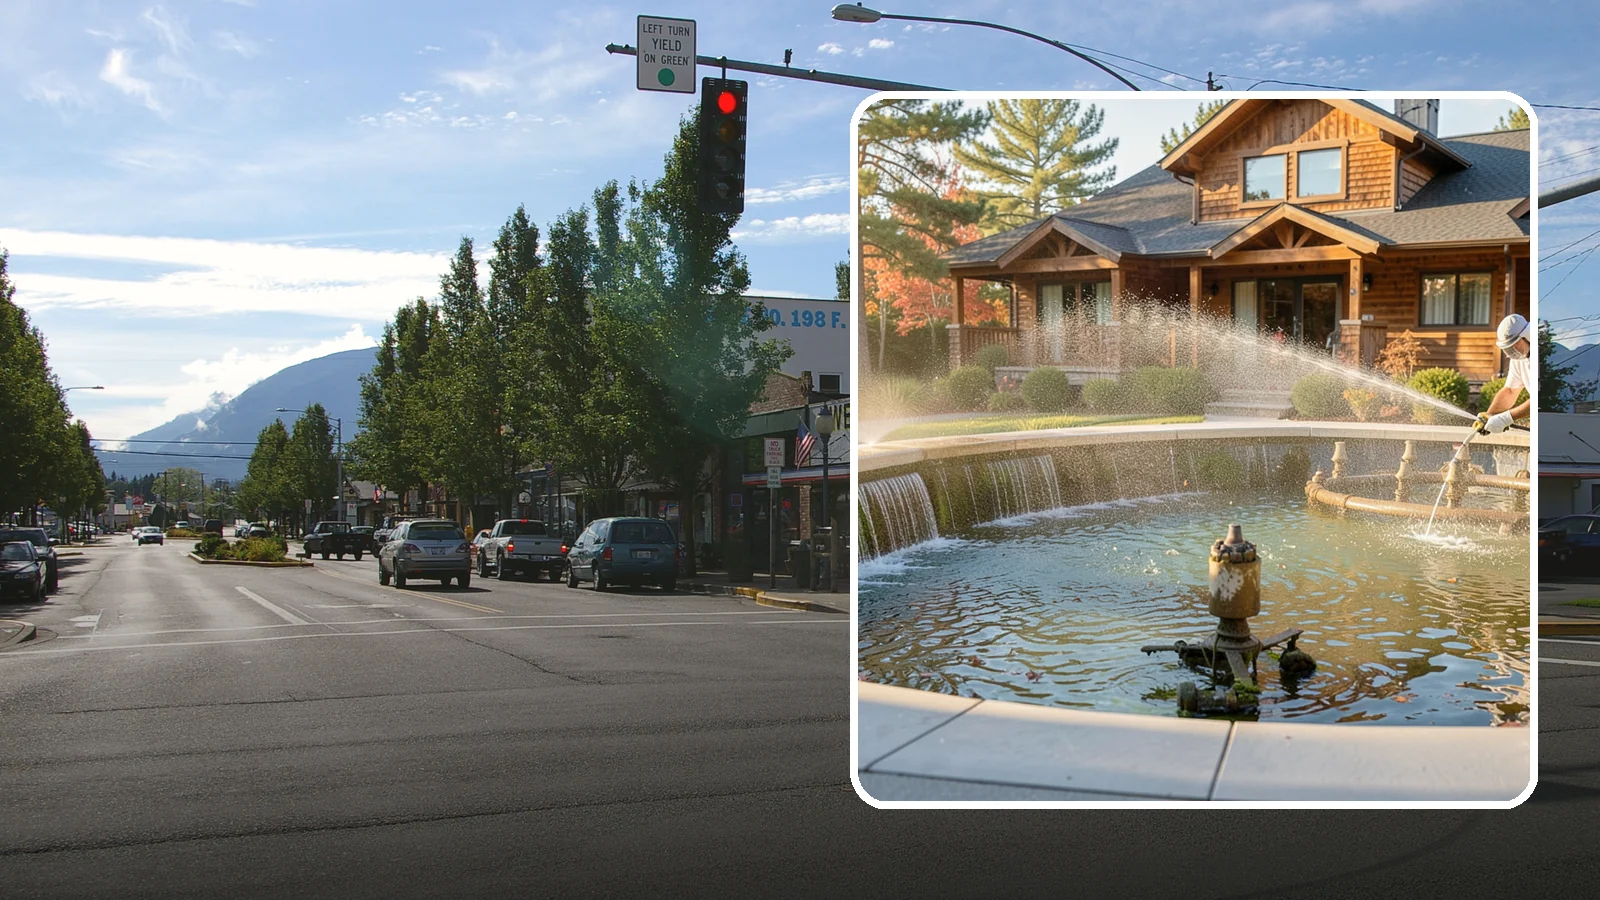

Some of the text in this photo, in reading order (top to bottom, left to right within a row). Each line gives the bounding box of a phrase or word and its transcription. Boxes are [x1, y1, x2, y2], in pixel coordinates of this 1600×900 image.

[643, 24, 690, 36] LEFT TURN
[652, 38, 682, 51] YIELD
[791, 309, 826, 328] 198
[831, 311, 847, 329] F.
